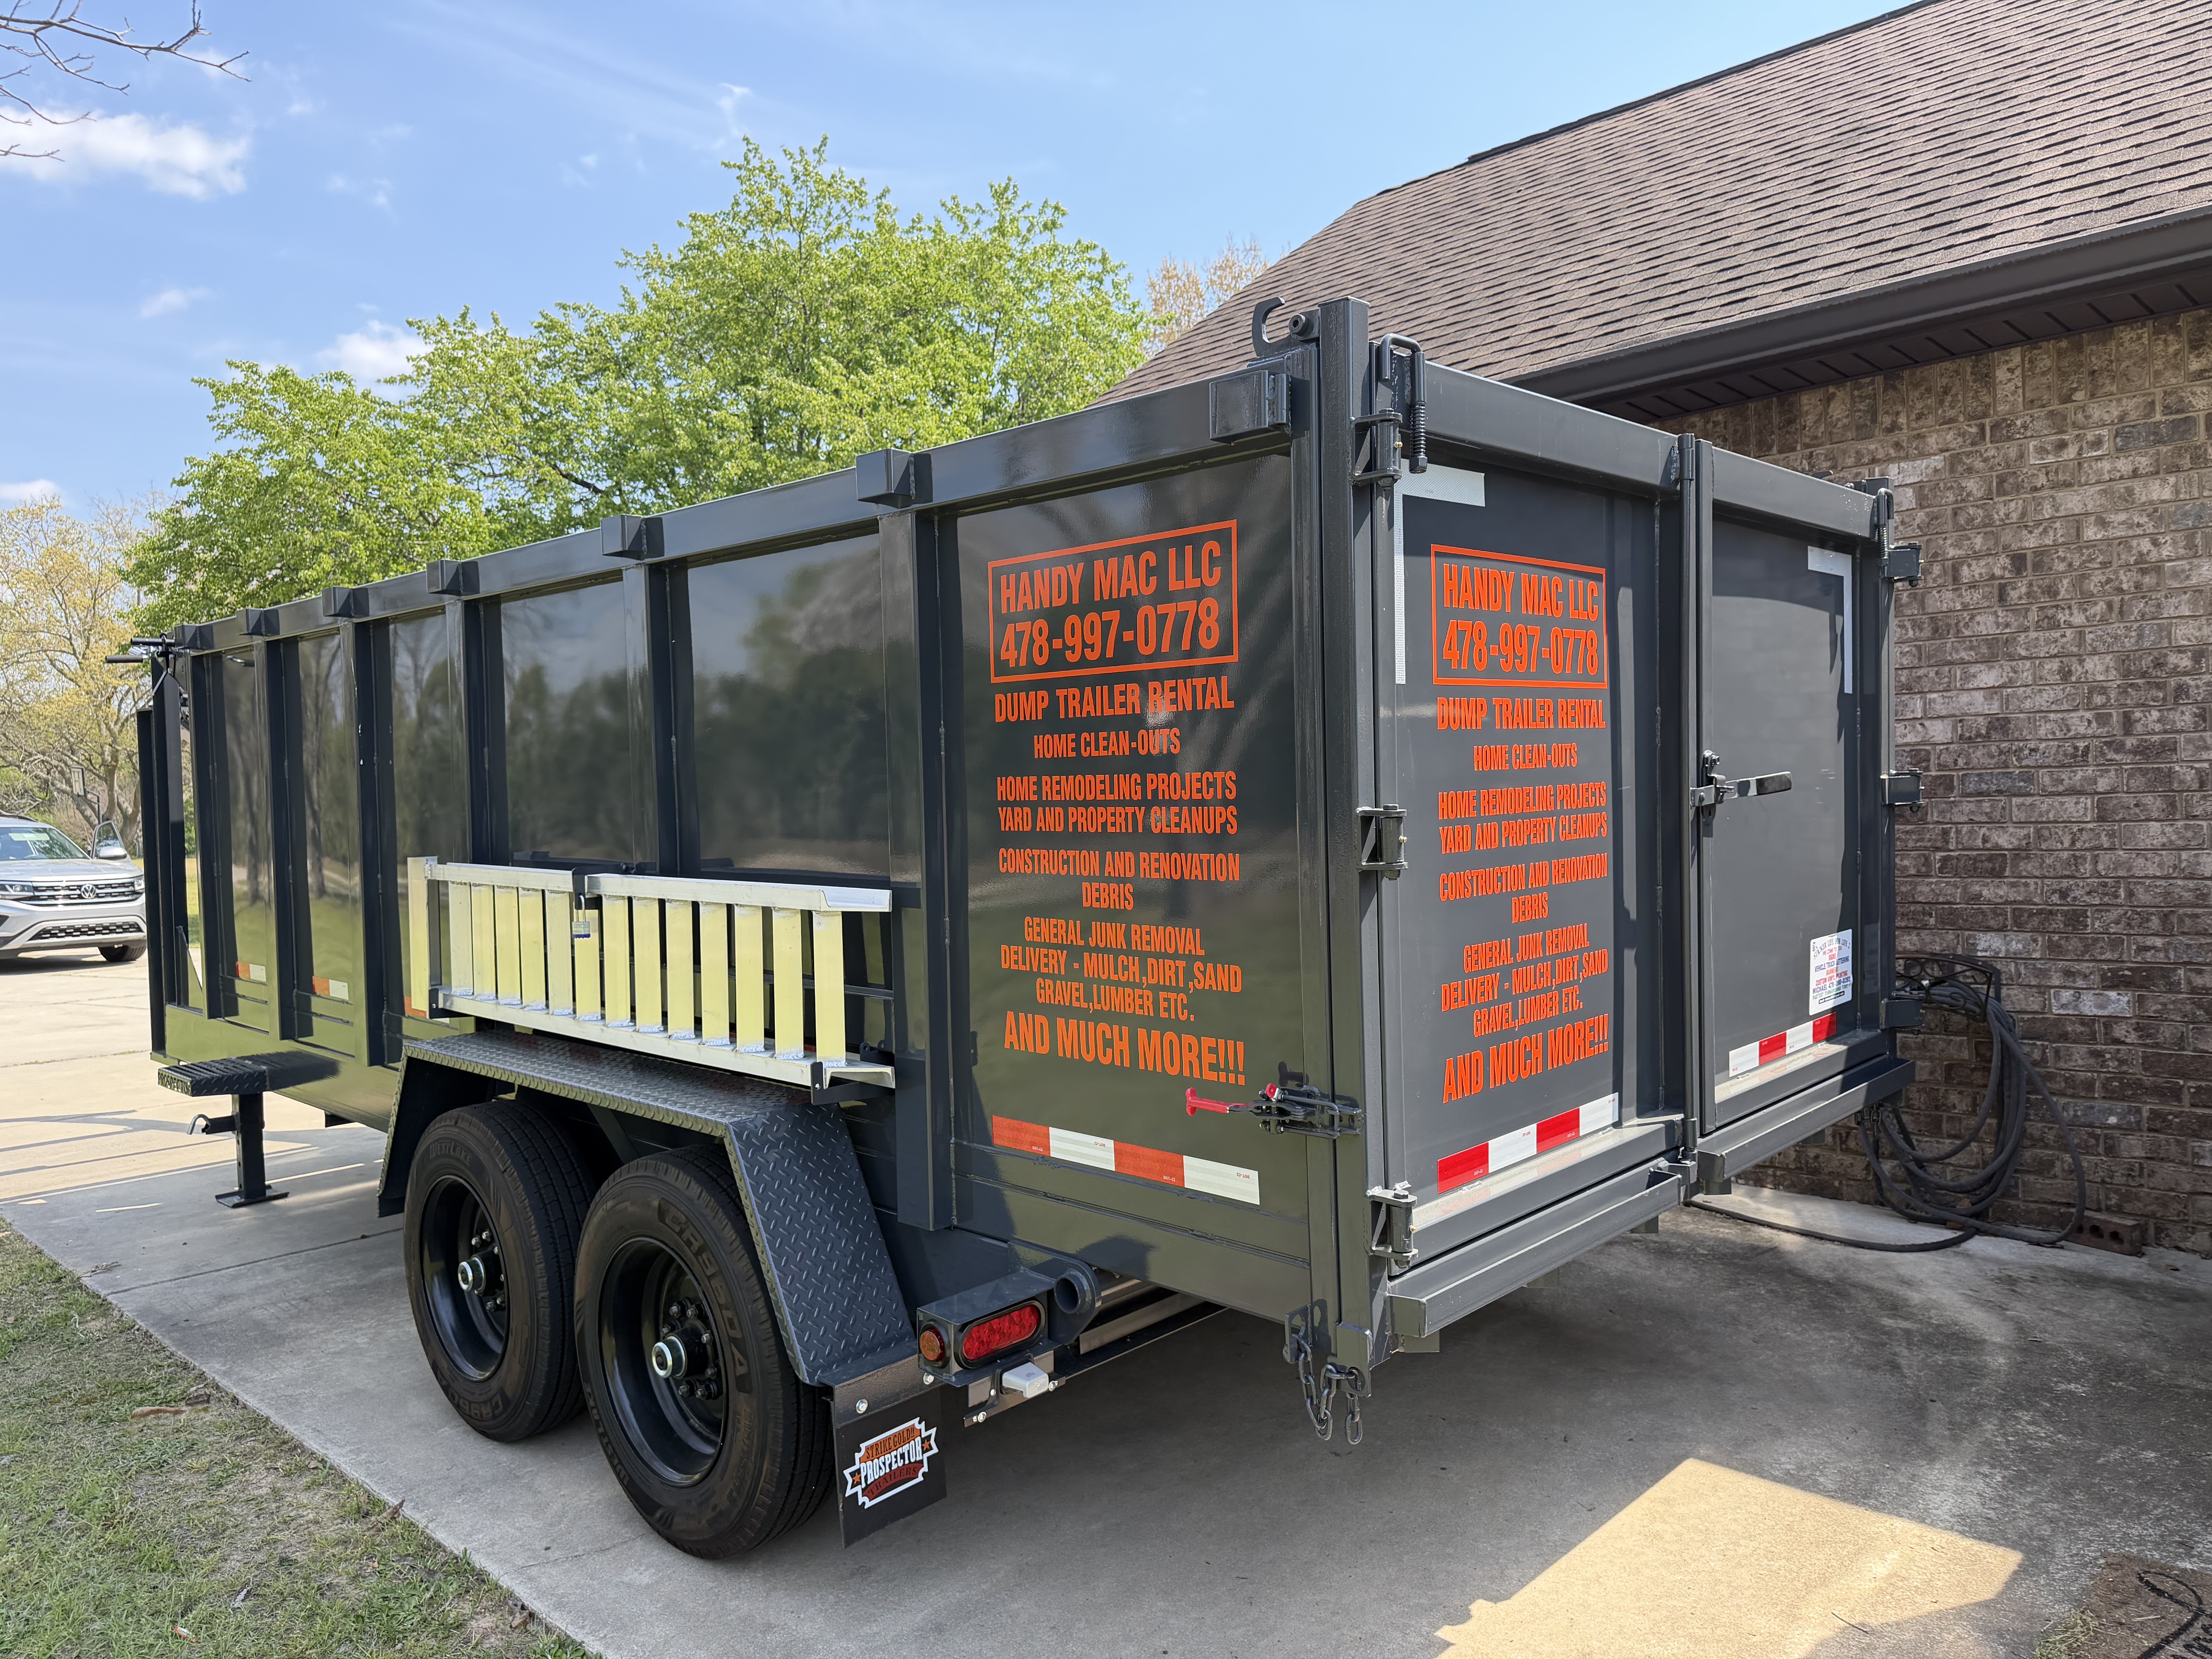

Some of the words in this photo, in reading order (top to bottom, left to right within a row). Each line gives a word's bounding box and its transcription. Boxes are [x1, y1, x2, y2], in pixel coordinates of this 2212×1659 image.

[1002, 564, 1084, 613] HANDY
[1095, 551, 1157, 601] MAC
[1170, 541, 1221, 591] LLC
[1444, 565, 1515, 613] HANDY
[1522, 574, 1563, 618] MAC
[1570, 580, 1599, 622] LLC
[1001, 598, 1219, 667] 478-997-0778
[1444, 621, 1598, 675] 478-997-0778
[996, 691, 1048, 722] DUMP
[1056, 684, 1140, 718] TRAILER
[1149, 677, 1234, 713] RENTAL
[1438, 698, 1487, 730] DUMP
[1493, 699, 1554, 729] TRAILER
[1559, 699, 1606, 728] RENTAL
[1035, 734, 1076, 758] HOME
[1081, 728, 1180, 757] CLEAN-OUTS
[1475, 746, 1509, 771] HOME
[1513, 744, 1578, 770] CLEAN-OUTS
[998, 776, 1037, 801] HOME
[1042, 774, 1141, 800] REMODELING
[1147, 771, 1236, 800] PROJECTS
[1439, 791, 1477, 820] HOME
[1481, 786, 1554, 816] REMODELING
[1558, 782, 1607, 809] PROJECTS
[999, 807, 1032, 831] YARD
[1037, 807, 1064, 831] AND
[1069, 807, 1145, 833] PROPERTY
[1151, 806, 1237, 834] CLEANUPS
[1440, 825, 1472, 854] YARD
[1476, 823, 1499, 850] AND
[1503, 818, 1556, 847] PROPERTY
[1560, 813, 1607, 841] CLEANUPS
[999, 849, 1100, 876] CONSTRUCTION
[1106, 852, 1135, 877] AND
[1140, 853, 1239, 881] RENOVATION
[1440, 865, 1526, 902] CONSTRUCTION
[1530, 862, 1550, 889] AND
[1553, 854, 1607, 885] RENOVATION
[1083, 883, 1133, 910] DEBRIS
[1513, 893, 1548, 923] DEBRIS
[1025, 917, 1084, 945] GENERAL
[1089, 922, 1127, 949] JUNK
[1132, 925, 1205, 955] REMOVAL
[1465, 939, 1514, 974] GENERAL
[1517, 933, 1543, 962] JUNK
[1547, 924, 1590, 956] REMOVAL
[1001, 945, 1067, 975] DELIVERY
[1815, 963, 1826, 972] VEHICLE
[1159, 992, 1194, 1021] ETC.
[1442, 974, 1500, 1012] DELIVERY
[1563, 986, 1583, 1013] ETC.
[1813, 984, 1827, 994] MICHAEL
[1005, 1011, 1049, 1054] AND
[1057, 1018, 1130, 1067] MUCH
[1139, 1029, 1245, 1085] MORE!!!
[1444, 1051, 1484, 1104] AND
[1491, 1034, 1543, 1089] MUCH
[1549, 1015, 1609, 1070] MORE!!!
[666, 1210, 750, 1379] CR960A
[866, 1436, 892, 1459] STRIKE
[893, 1427, 915, 1448] GOLD!!
[860, 1436, 922, 1488] PROSPECTOR
[868, 1467, 917, 1495] TRAILERS
